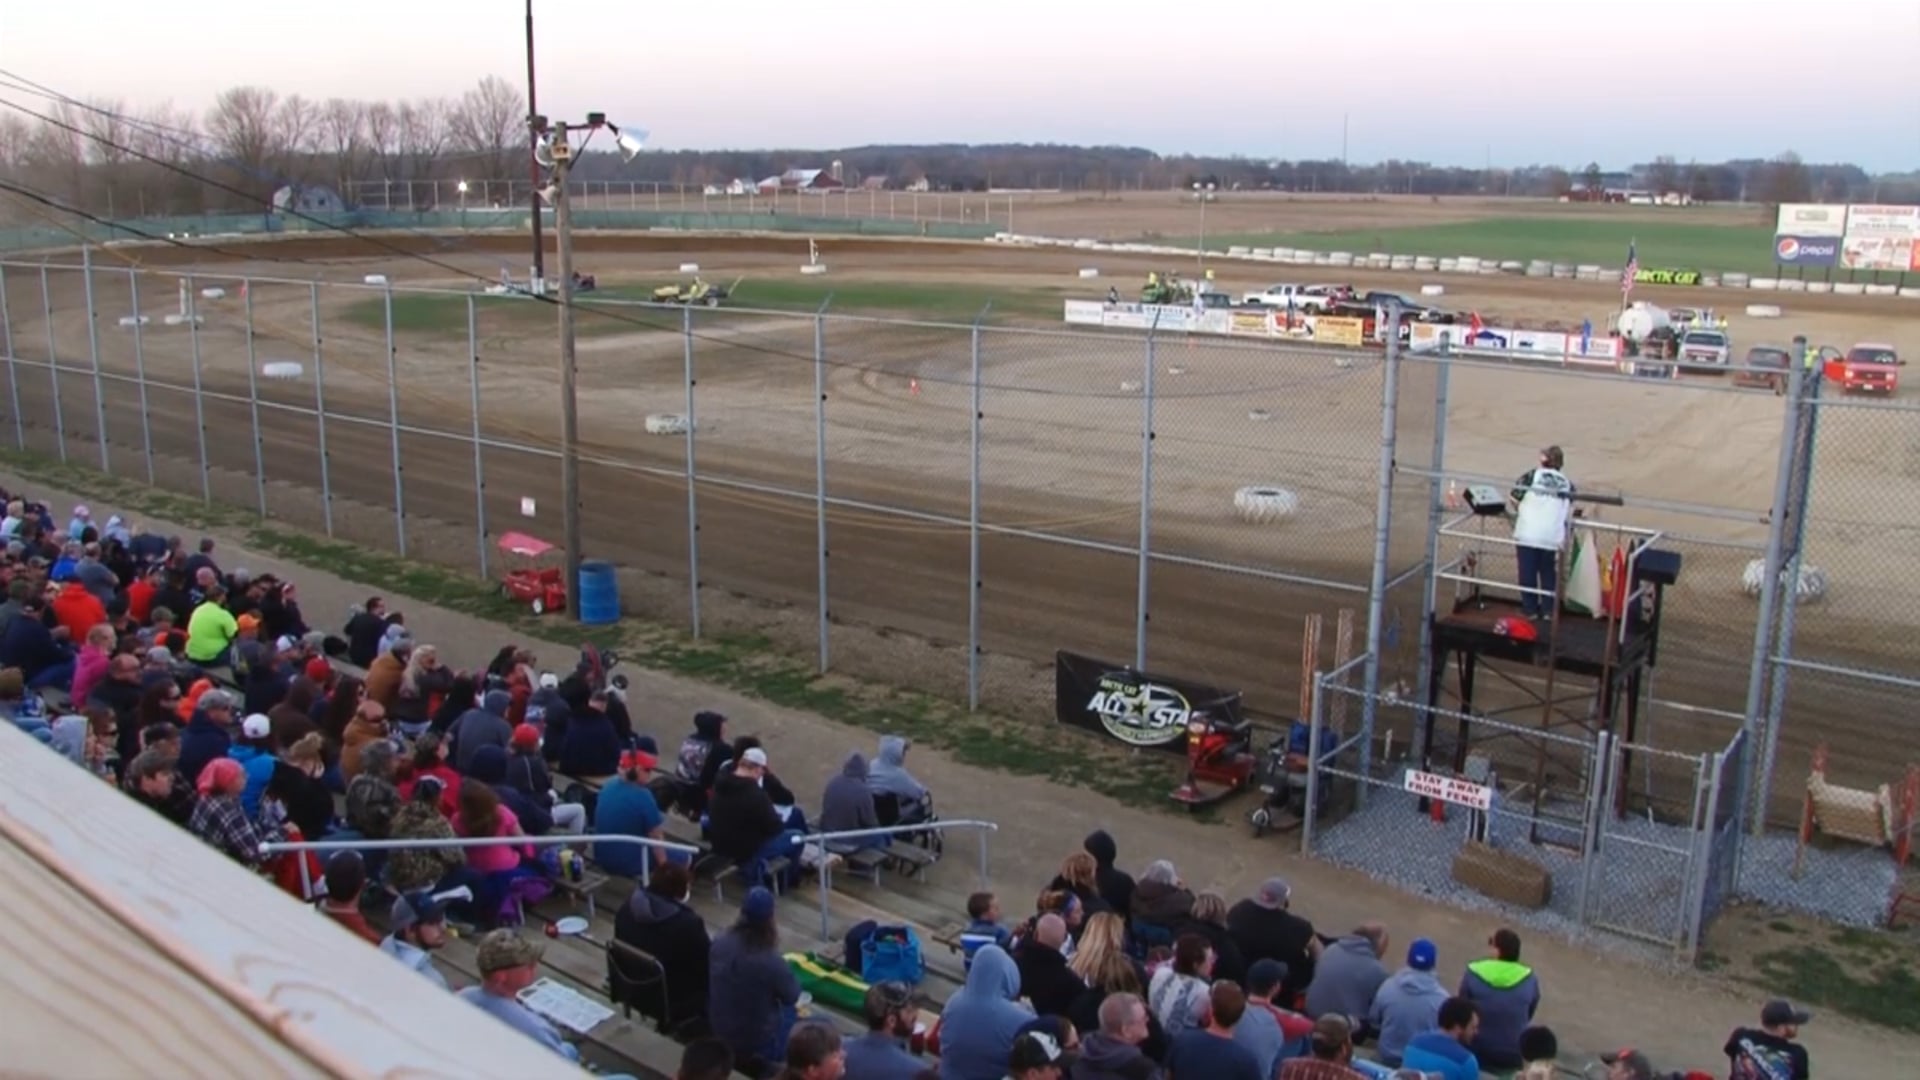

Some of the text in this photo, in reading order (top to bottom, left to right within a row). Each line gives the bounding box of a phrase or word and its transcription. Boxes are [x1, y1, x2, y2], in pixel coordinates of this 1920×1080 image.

[1800, 244, 1834, 256] pepsi
[1675, 271, 1698, 284] CAT
[1086, 691, 1124, 716] ALL
[1150, 707, 1196, 729] STA
[1408, 781, 1485, 807] FROM FENCE
[1415, 772, 1480, 794] STAY AWAY
